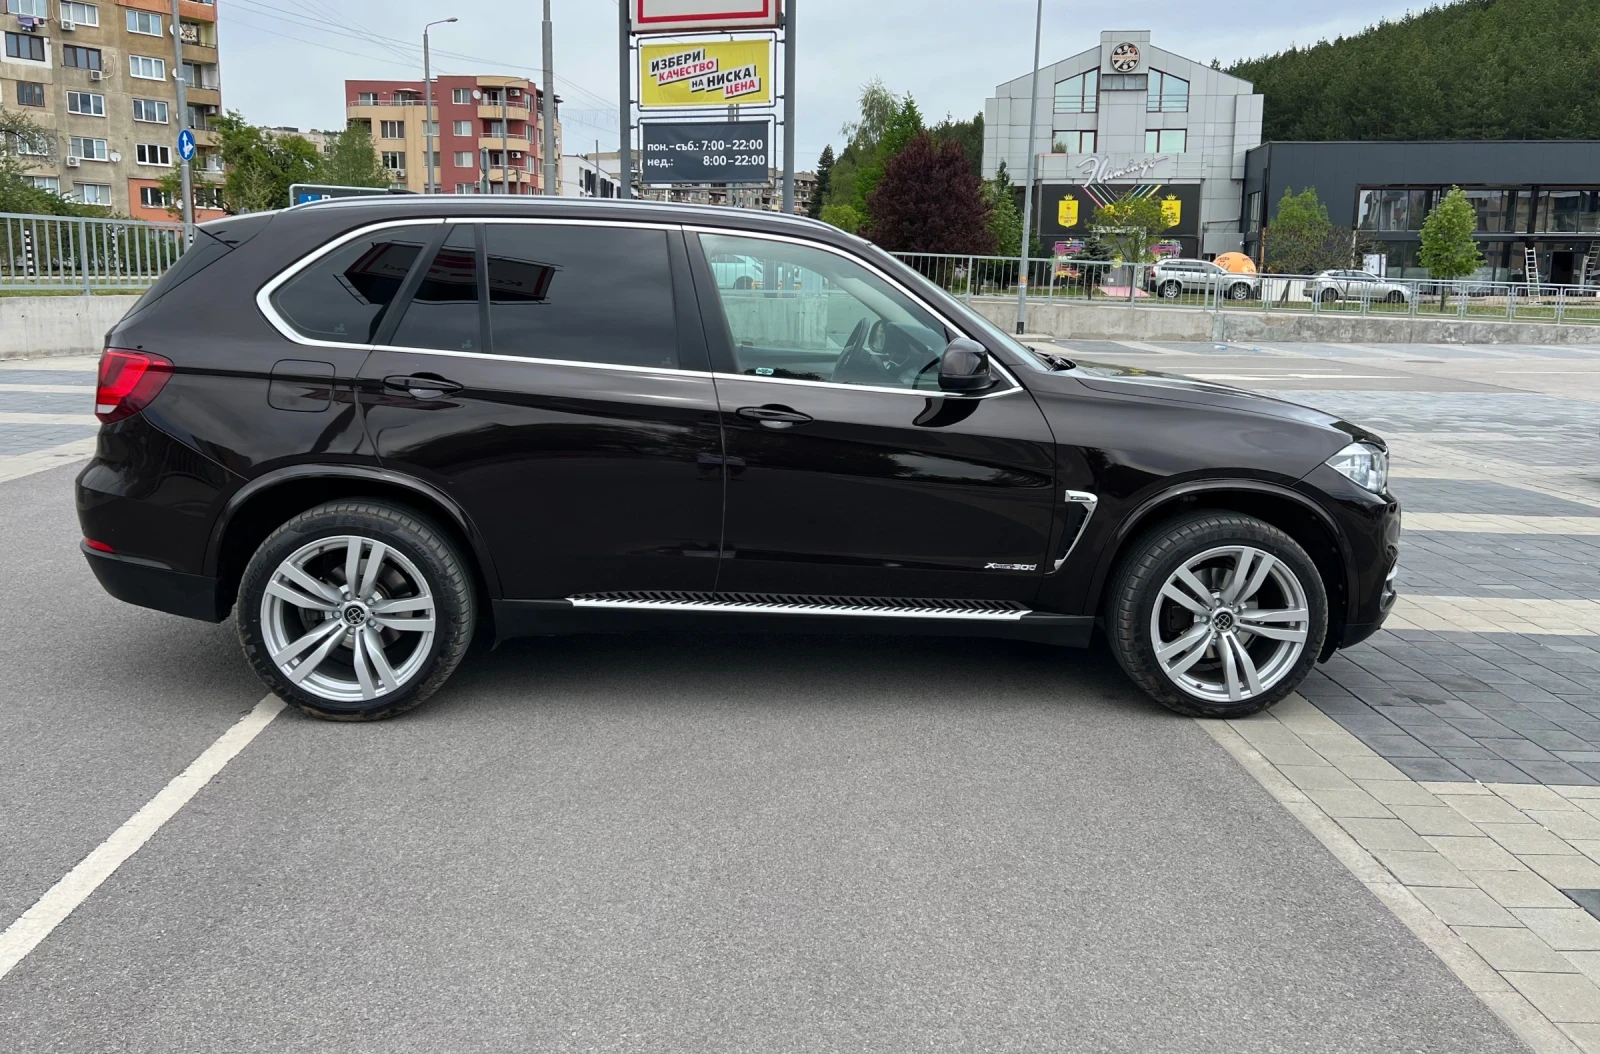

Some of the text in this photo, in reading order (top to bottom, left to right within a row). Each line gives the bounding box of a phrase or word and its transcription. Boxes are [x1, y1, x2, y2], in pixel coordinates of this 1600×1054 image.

[651, 50, 701, 73] ИЗБЕРИ
[658, 60, 715, 82] КАЧЕСТВО
[691, 67, 752, 89] НА НИСКА
[725, 79, 756, 95] ЦЕНА
[647, 158, 674, 169] нед.:
[1076, 155, 1170, 188] Flamingo
